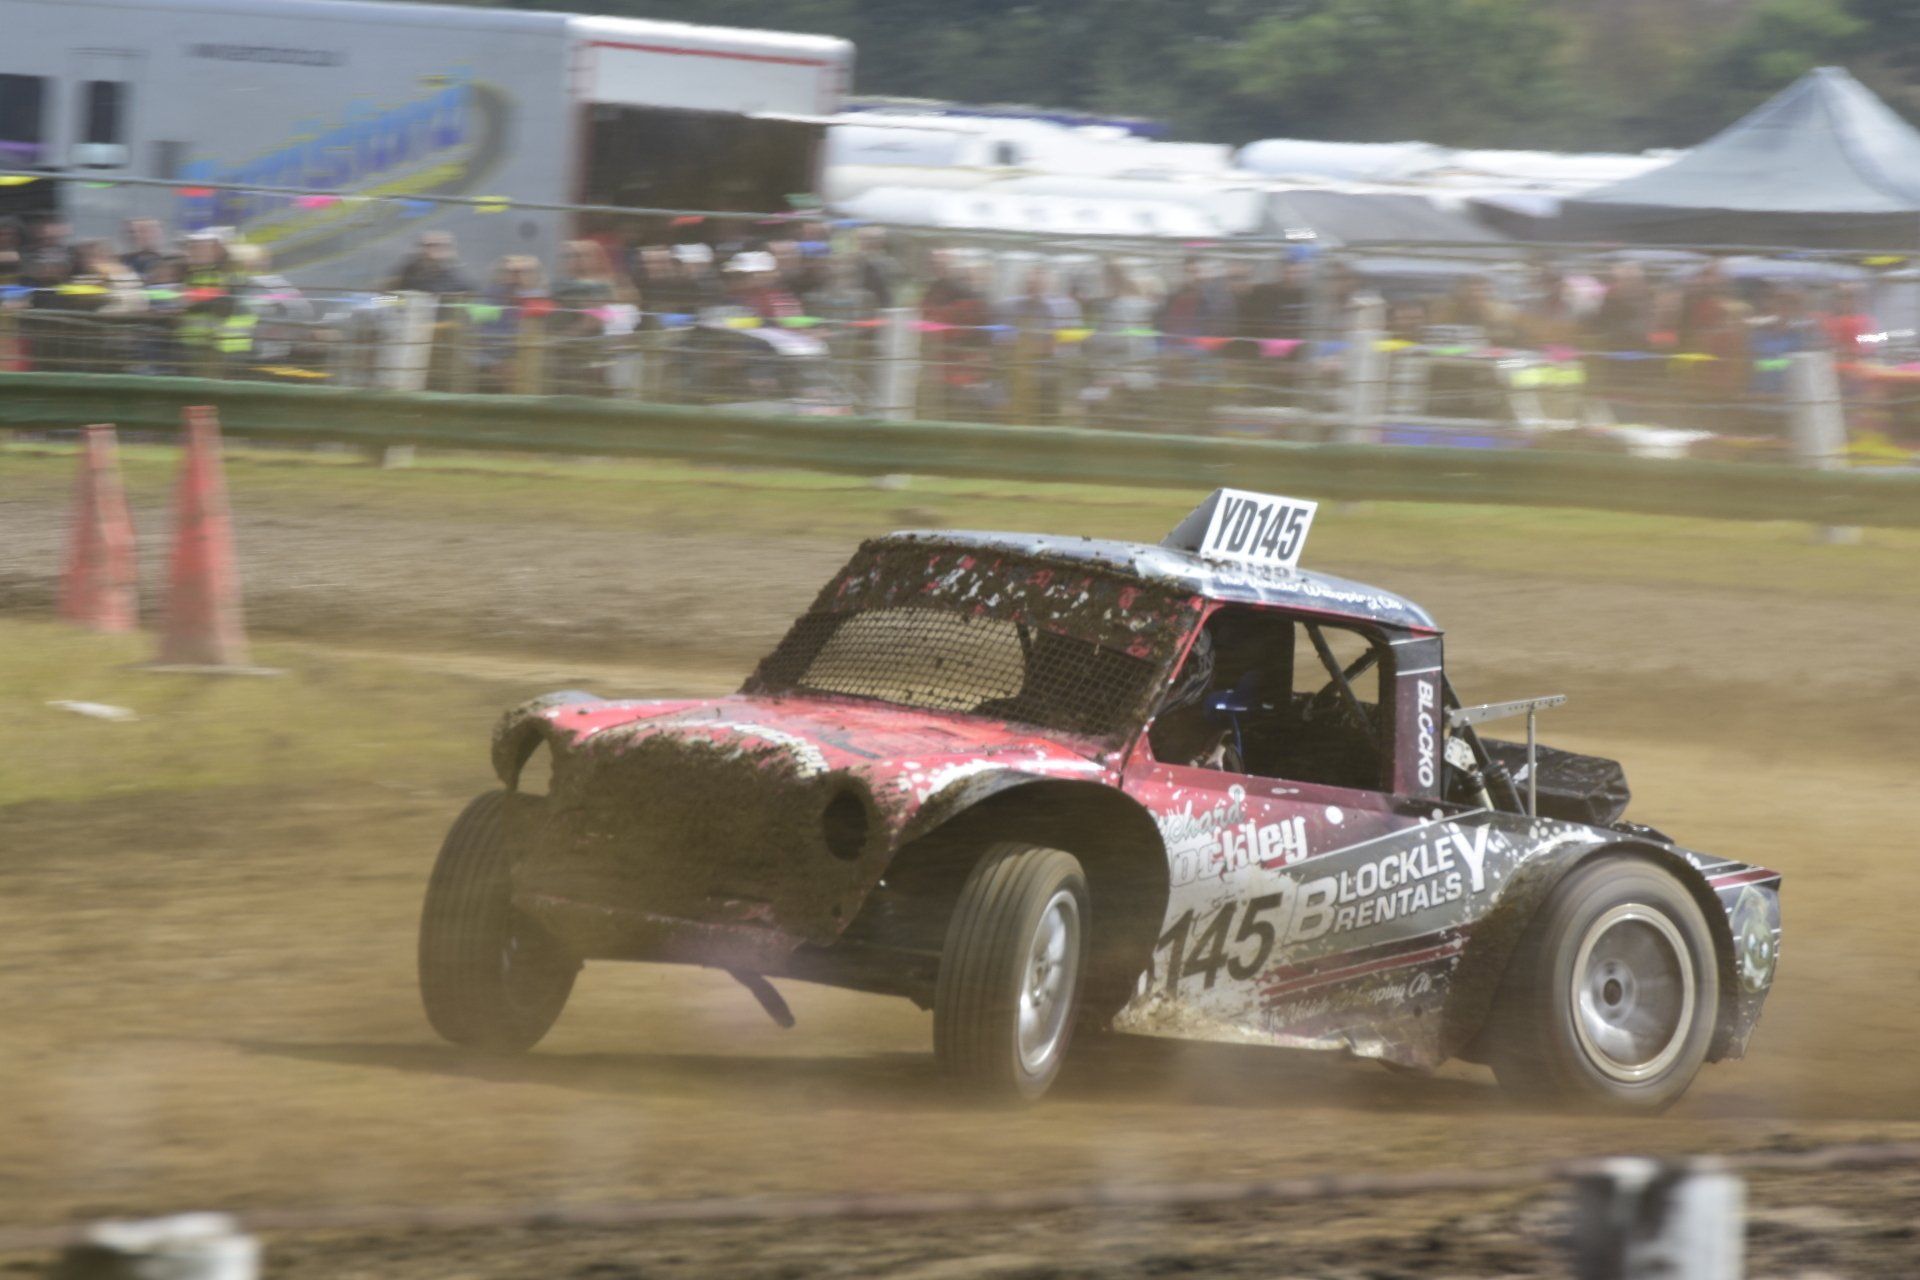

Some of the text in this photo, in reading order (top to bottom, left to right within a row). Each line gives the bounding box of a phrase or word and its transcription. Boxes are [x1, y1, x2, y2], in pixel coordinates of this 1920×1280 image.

[1212, 496, 1308, 561] YD145
[1417, 679, 1435, 788] BLOCKO
[1283, 823, 1491, 945] BLOCKLEY
[1333, 871, 1463, 934] RENTALS
[1157, 891, 1284, 1000] 145
